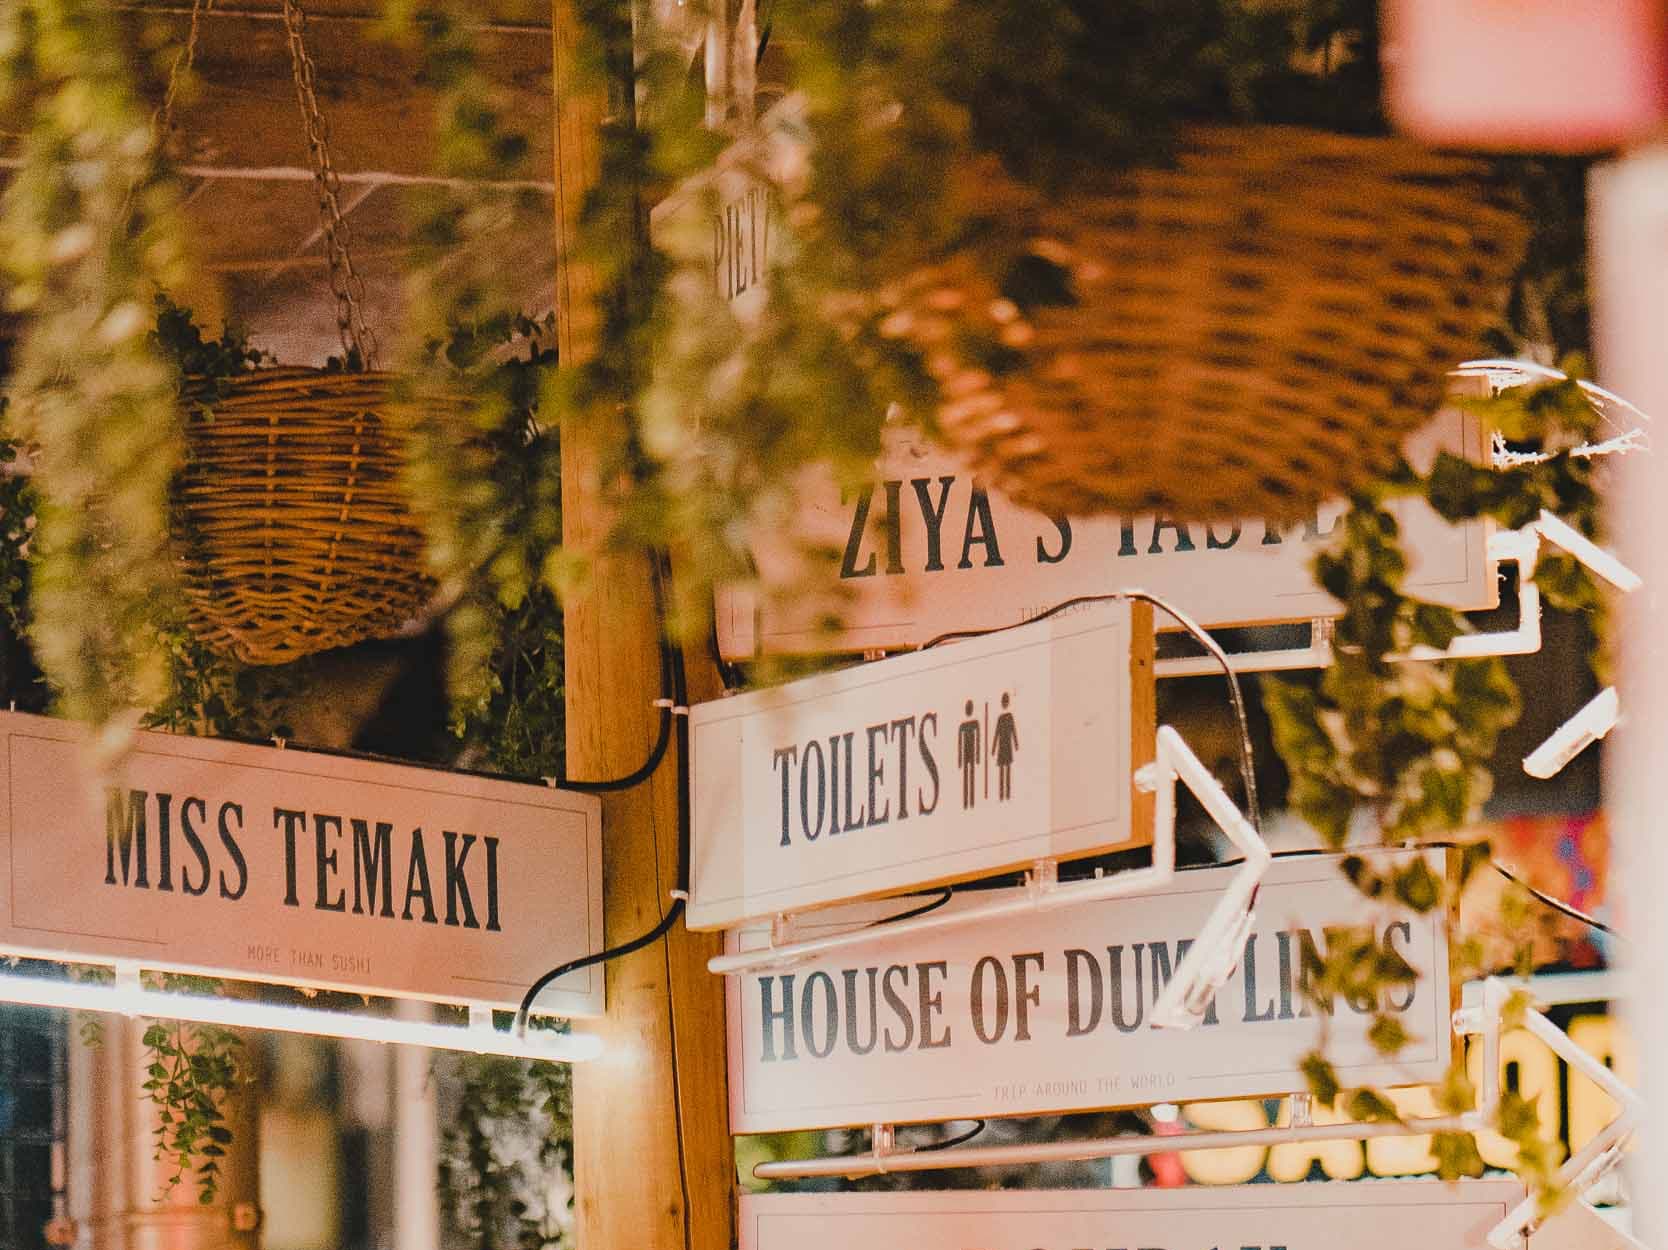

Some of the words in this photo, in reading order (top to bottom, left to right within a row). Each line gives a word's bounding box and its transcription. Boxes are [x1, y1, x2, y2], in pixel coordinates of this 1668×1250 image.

[773, 712, 939, 847] TOILETS
[104, 787, 248, 900] MISS
[273, 807, 501, 931] TEMAKI
[247, 945, 280, 963] MORE
[291, 949, 323, 969] THAN
[332, 953, 372, 974] SUSHI
[758, 961, 951, 1062] HOUSE
[970, 952, 1044, 1044] OF
[993, 1085, 1027, 1101] TRIP
[1036, 1079, 1087, 1097] AROUND
[1096, 1076, 1120, 1092] THE
[1131, 1072, 1176, 1089] WORLD
